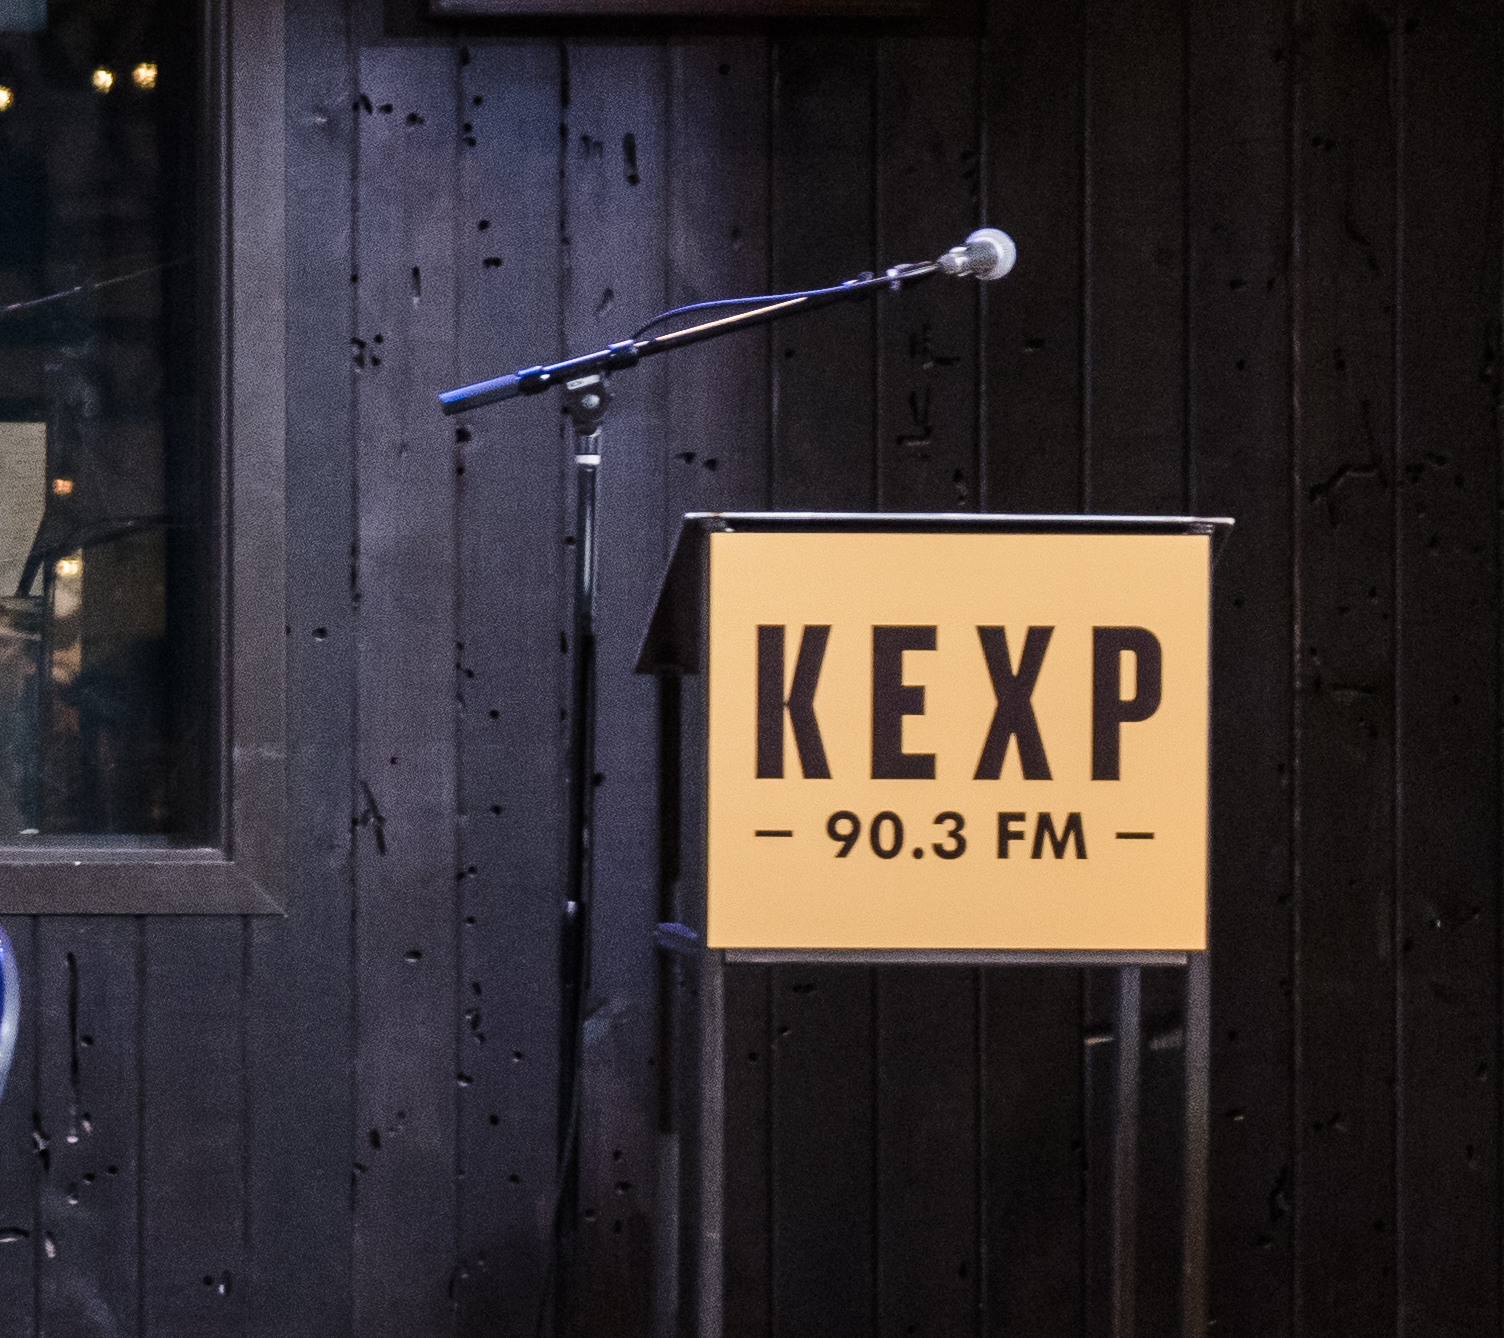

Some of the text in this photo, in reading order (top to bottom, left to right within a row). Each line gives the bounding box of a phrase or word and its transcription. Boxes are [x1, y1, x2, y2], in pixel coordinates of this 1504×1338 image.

[755, 623, 1164, 782] KEXP
[826, 810, 1089, 861] 90.3 FM
